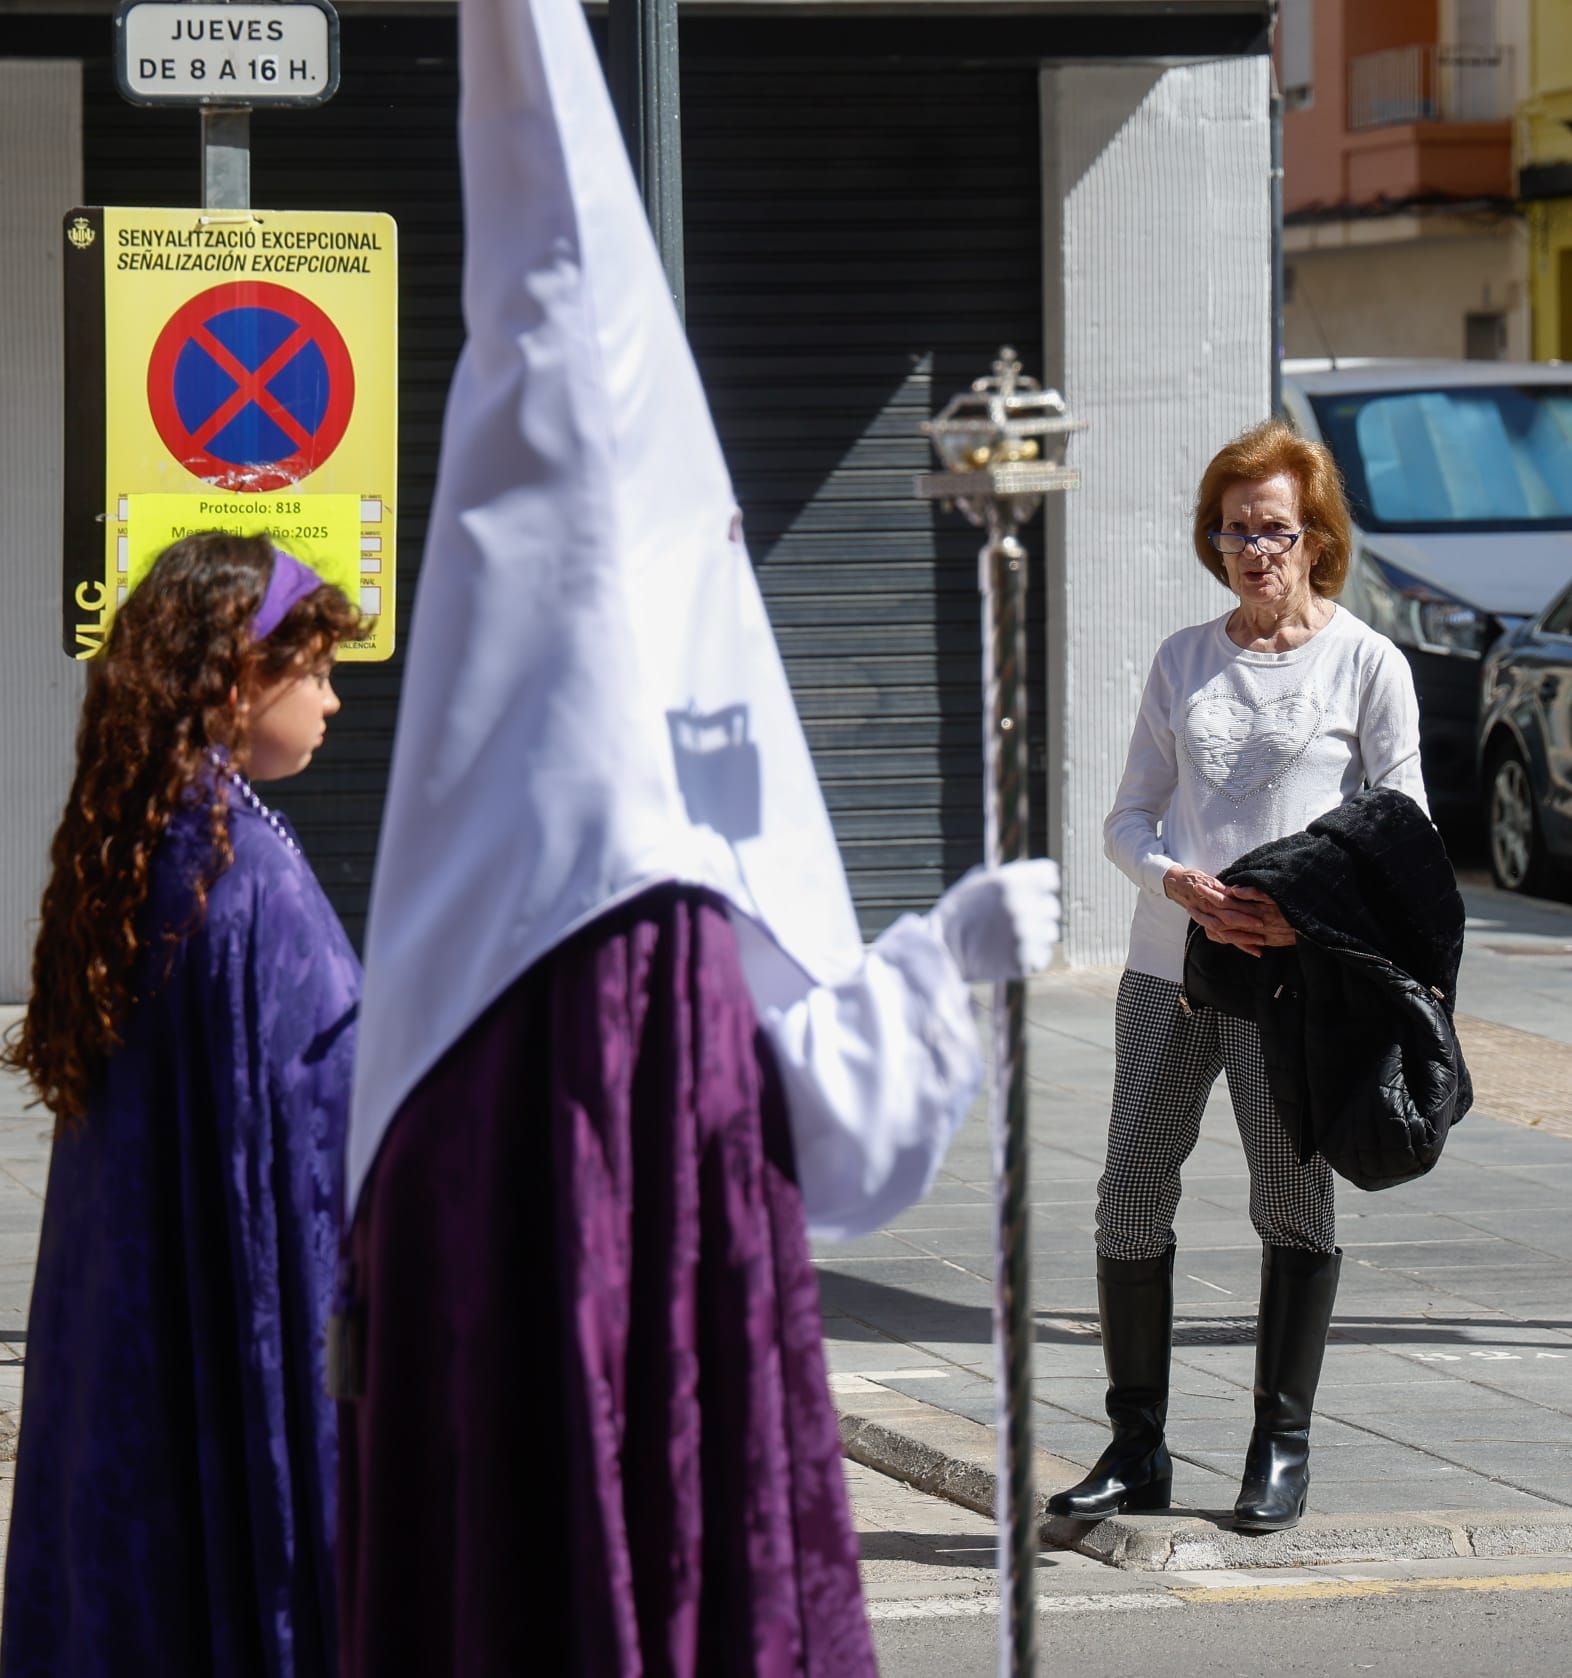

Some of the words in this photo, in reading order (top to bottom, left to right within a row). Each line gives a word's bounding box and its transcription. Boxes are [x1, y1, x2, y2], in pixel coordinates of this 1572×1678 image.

[171, 20, 284, 41] JUEVES
[139, 59, 176, 80] DE
[190, 59, 206, 80] 8
[218, 60, 237, 80] A
[248, 60, 277, 81] 16
[289, 60, 316, 80] H.
[118, 227, 256, 249] SENYALITZACIÓ
[262, 231, 383, 250] EXCEPCIONAL
[117, 249, 247, 272] SEÑALIZACIÓN
[251, 254, 371, 273] EXCEPCIONAL
[199, 501, 272, 514] Protocolo:
[275, 501, 301, 514] 818
[171, 526, 206, 538] Mes
[75, 580, 107, 661] VLC
